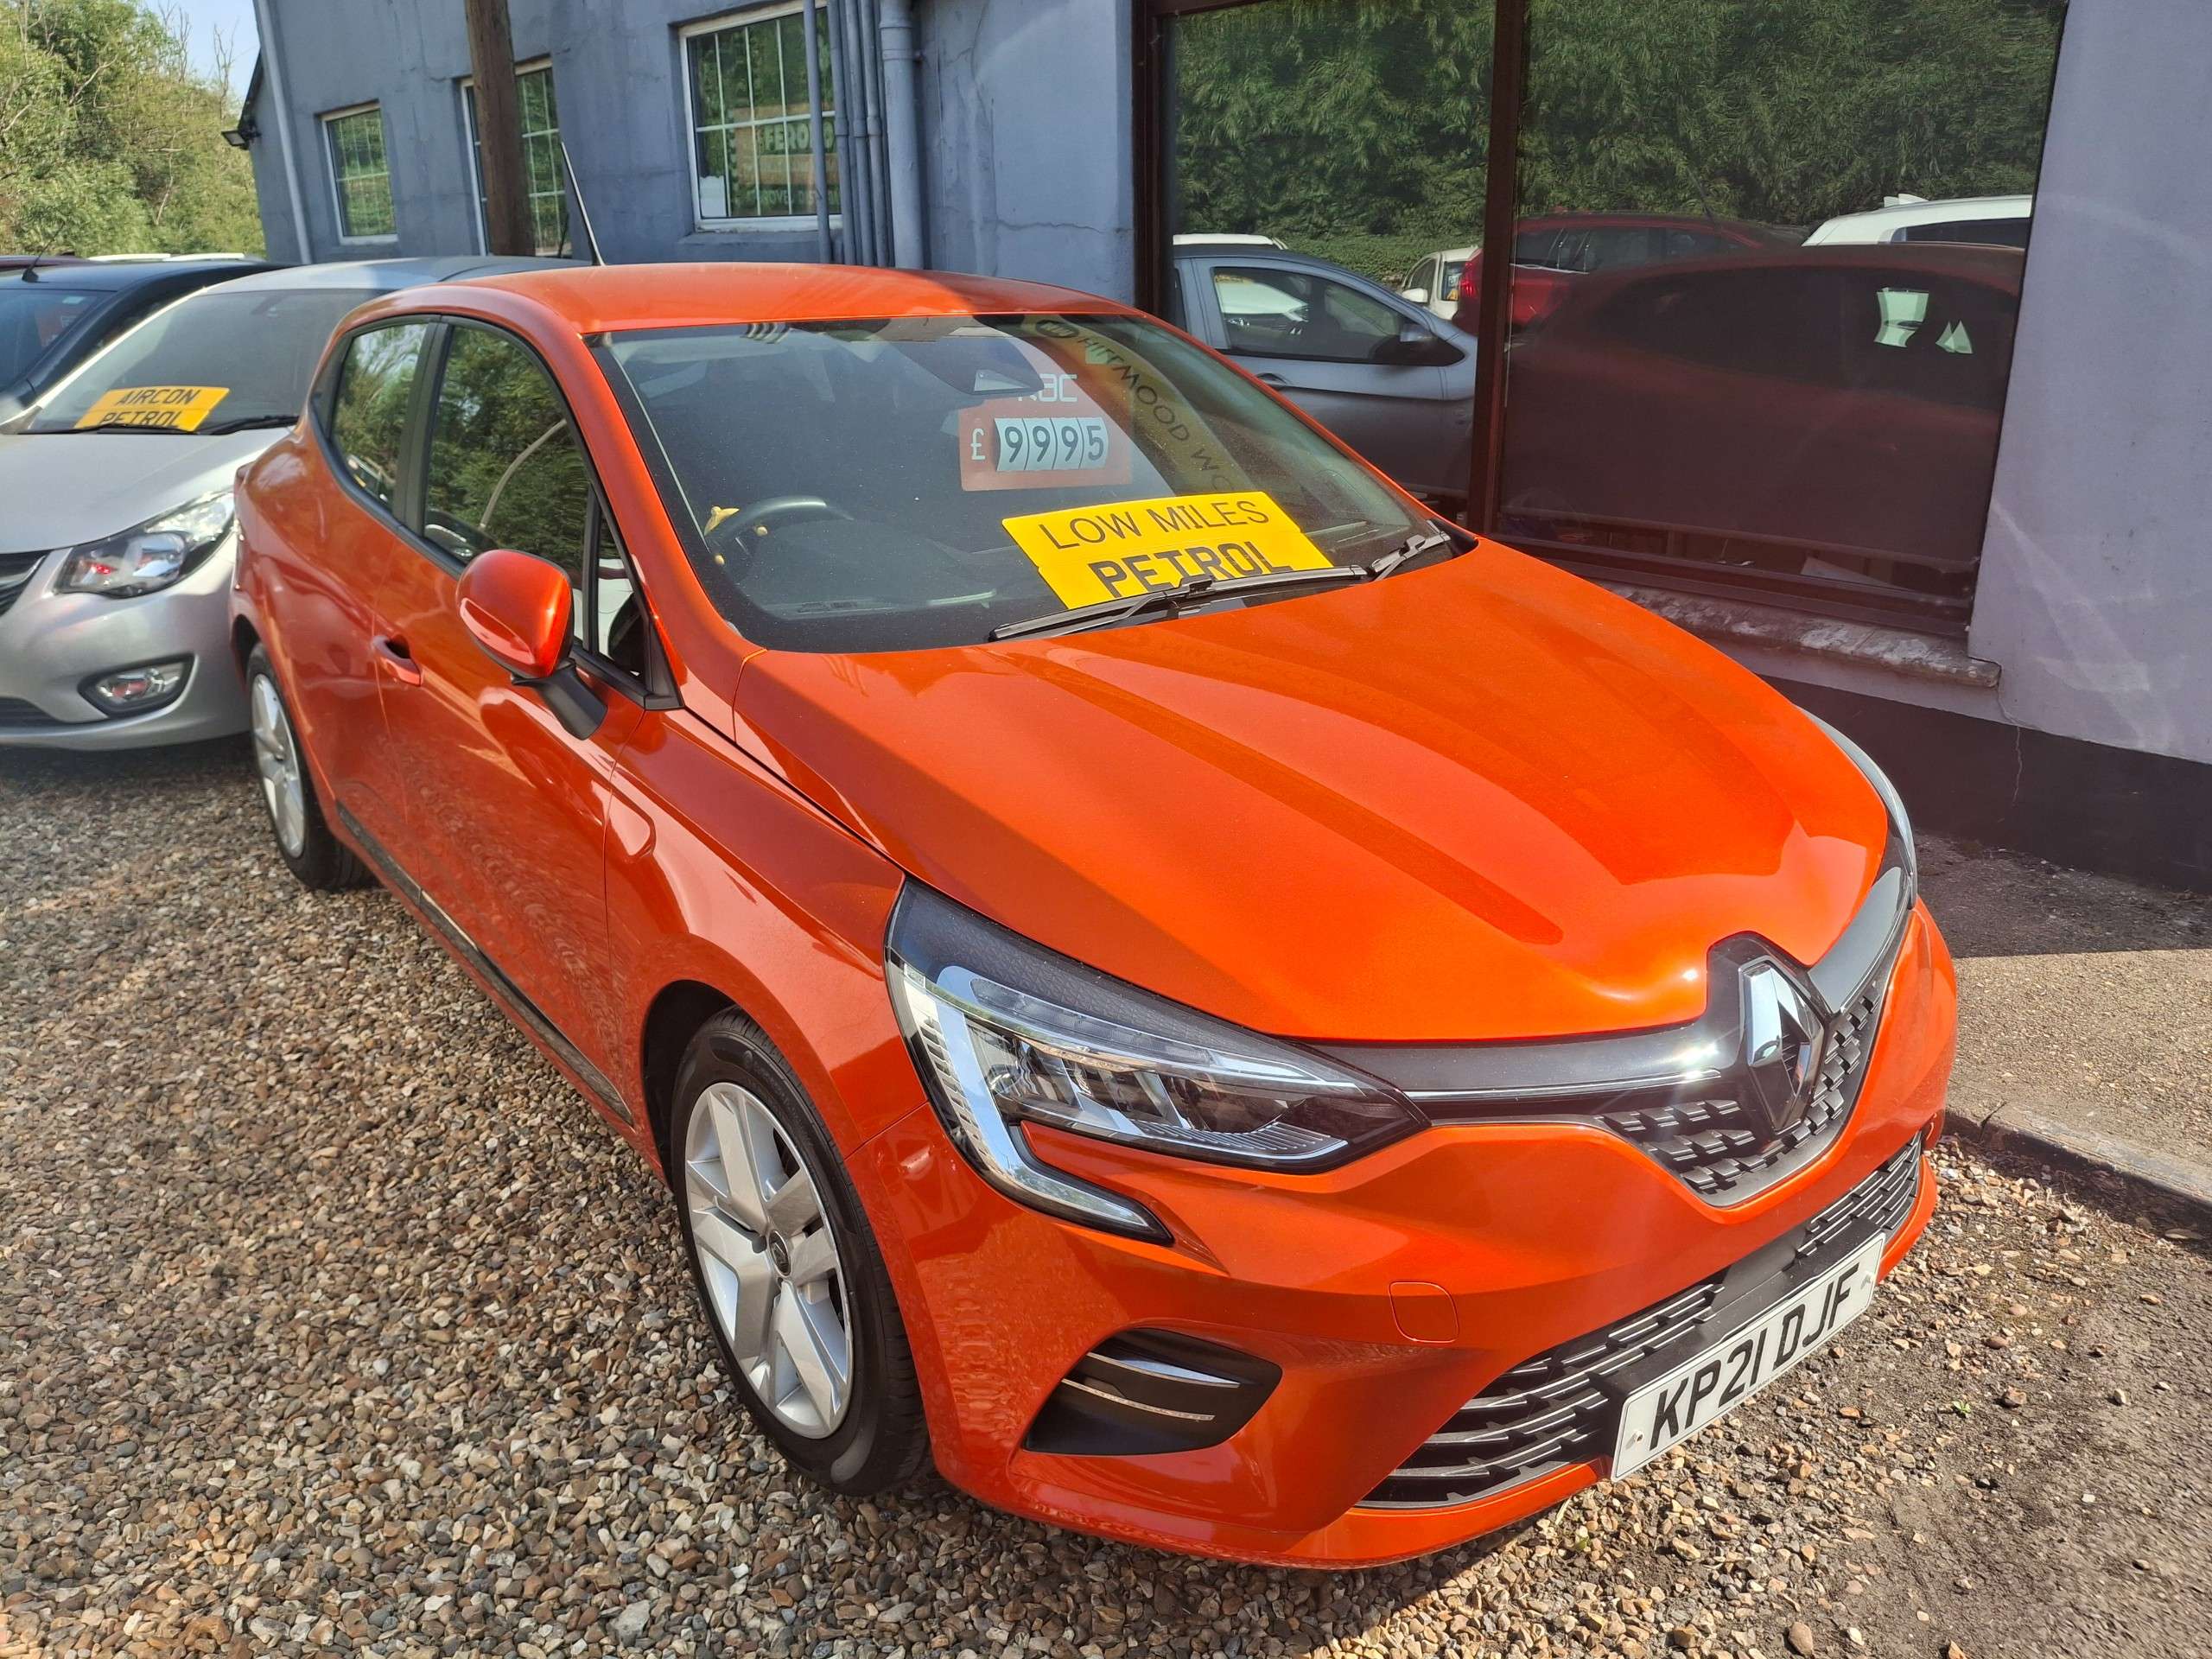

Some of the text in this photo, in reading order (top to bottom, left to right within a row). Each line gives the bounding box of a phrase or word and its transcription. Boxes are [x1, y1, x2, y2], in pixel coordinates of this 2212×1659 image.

[764, 121, 835, 149] FEROO
[116, 389, 202, 405] AIRCON
[97, 410, 183, 428] PETROL
[1004, 425, 1104, 463] 9995
[1039, 500, 1269, 550] LOW MILES
[1088, 540, 1293, 598] PETROL
[1649, 1262, 1859, 1452] KP21 DJF
